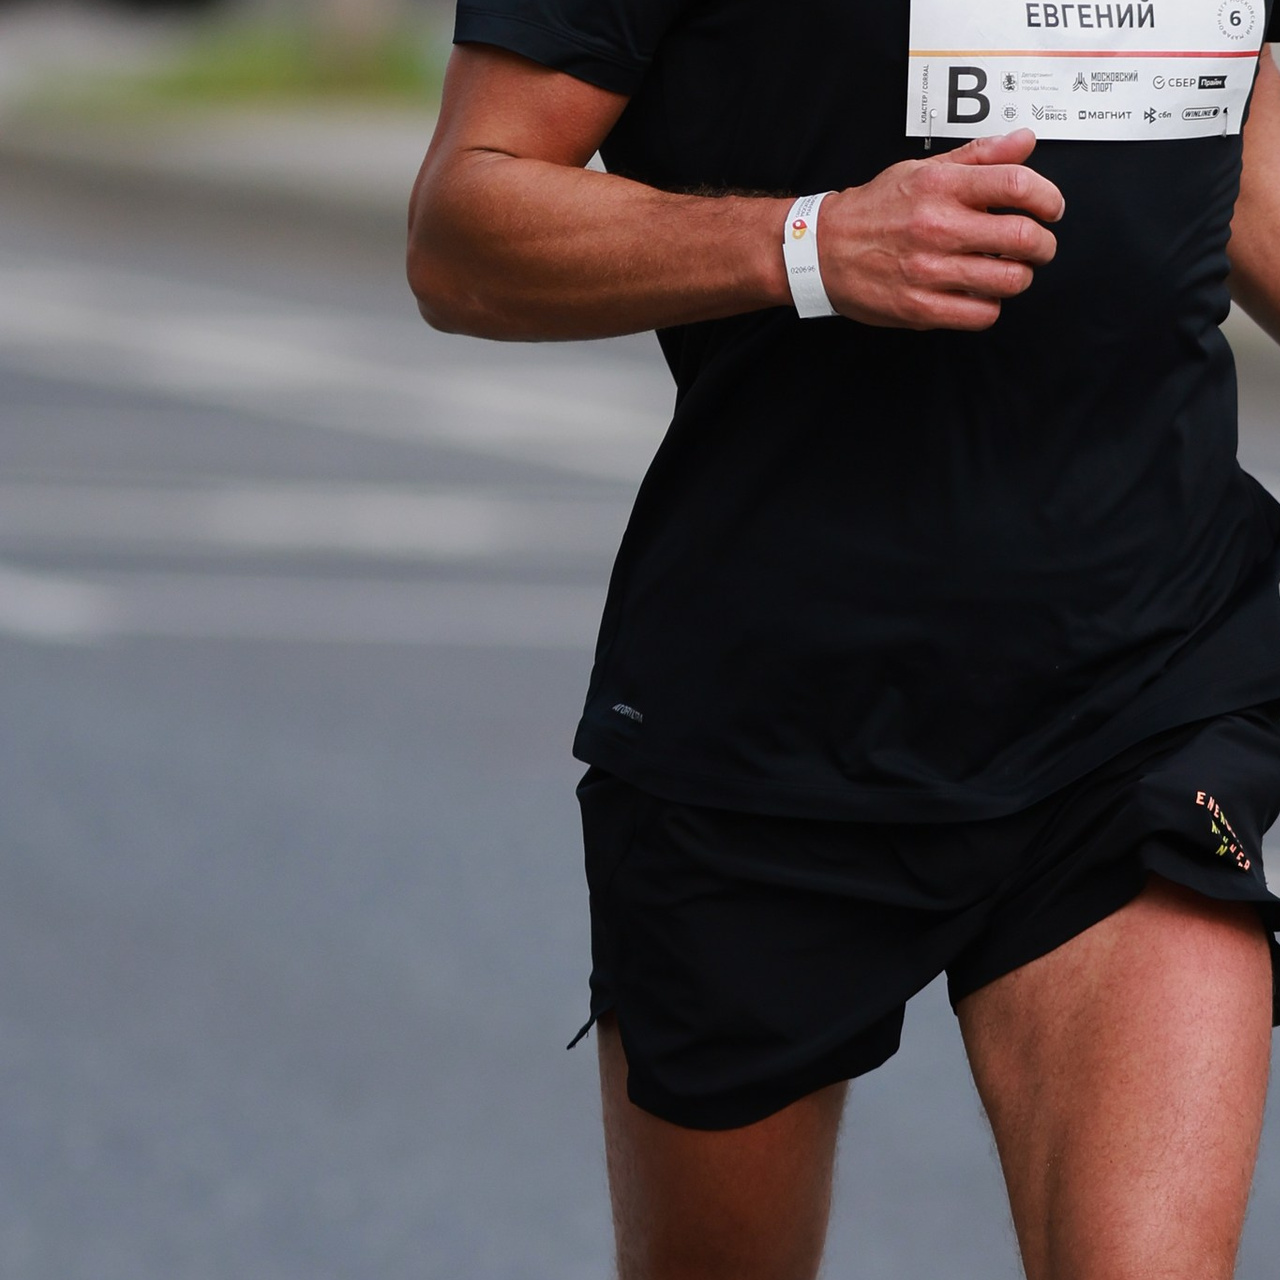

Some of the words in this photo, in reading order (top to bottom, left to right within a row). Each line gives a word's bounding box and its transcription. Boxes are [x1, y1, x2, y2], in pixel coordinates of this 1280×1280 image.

[1230, 10, 1242, 27] 6
[922, 64, 930, 90] CORRAL
[1091, 70, 1139, 82] МОСКОВСКИЙ
[1168, 78, 1196, 87] СБЕР
[1091, 82, 1113, 92] СПОРТ
[947, 66, 991, 124] B
[920, 94, 929, 124] КЛАСТЕР
[1045, 113, 1068, 121] BRICS
